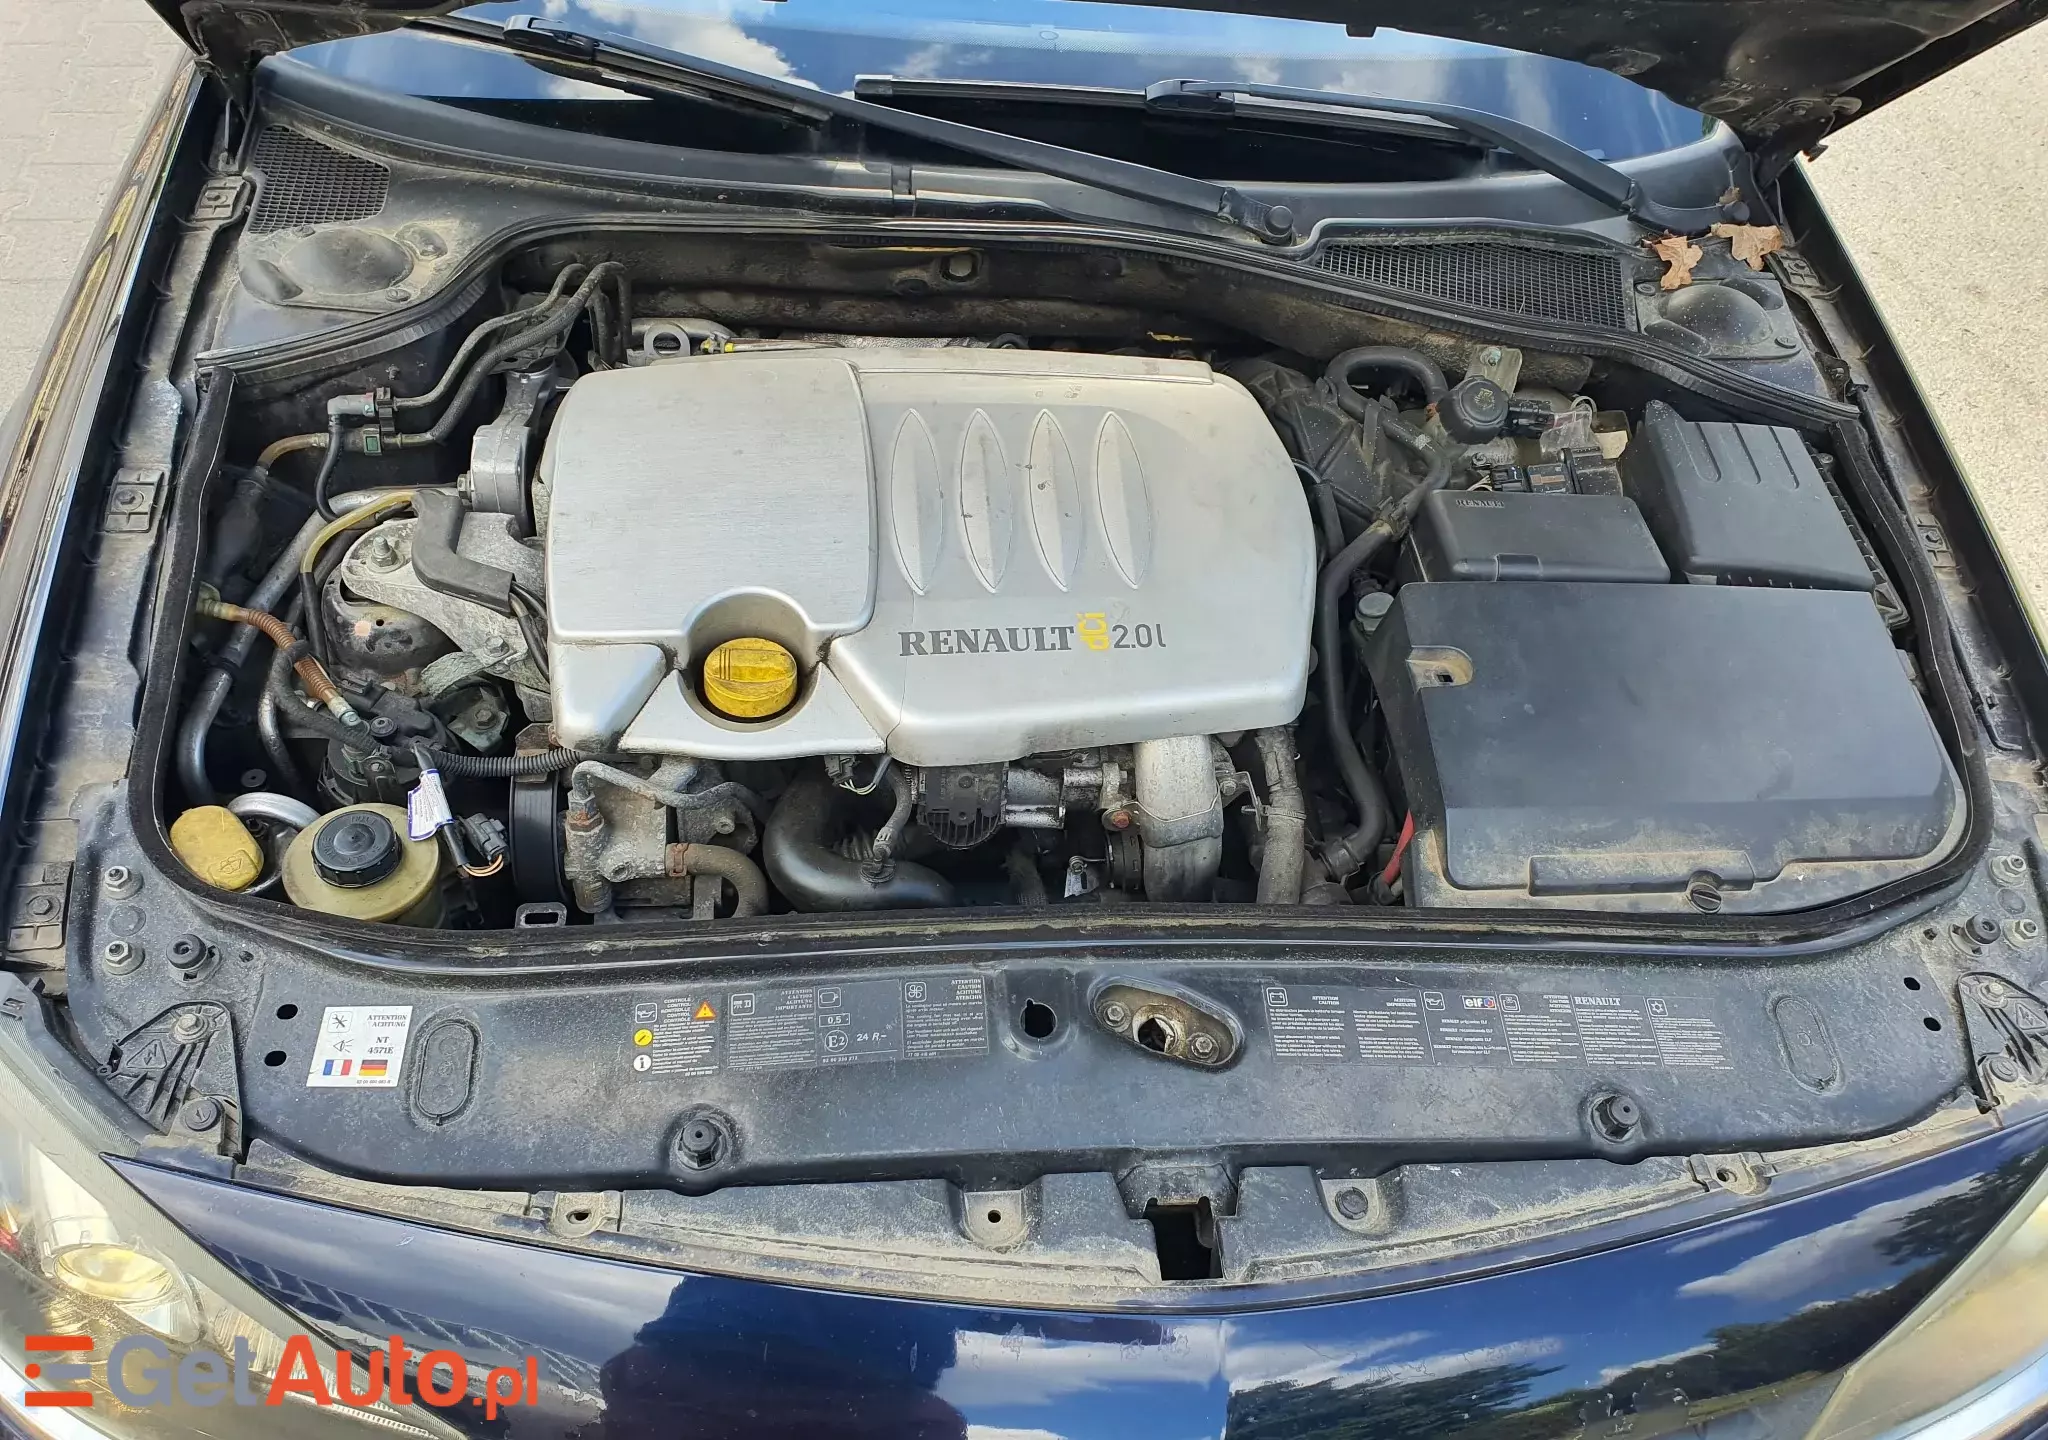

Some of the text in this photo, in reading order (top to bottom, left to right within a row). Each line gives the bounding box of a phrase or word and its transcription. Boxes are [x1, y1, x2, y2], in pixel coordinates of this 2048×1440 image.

[898, 625, 1075, 656] RENAULT
[1465, 998, 1483, 1007] elf
[1574, 997, 1621, 1006] RENAULT
[828, 1035, 845, 1048] E2
[857, 1034, 869, 1042] 24
[368, 1047, 394, 1055] 4571E
